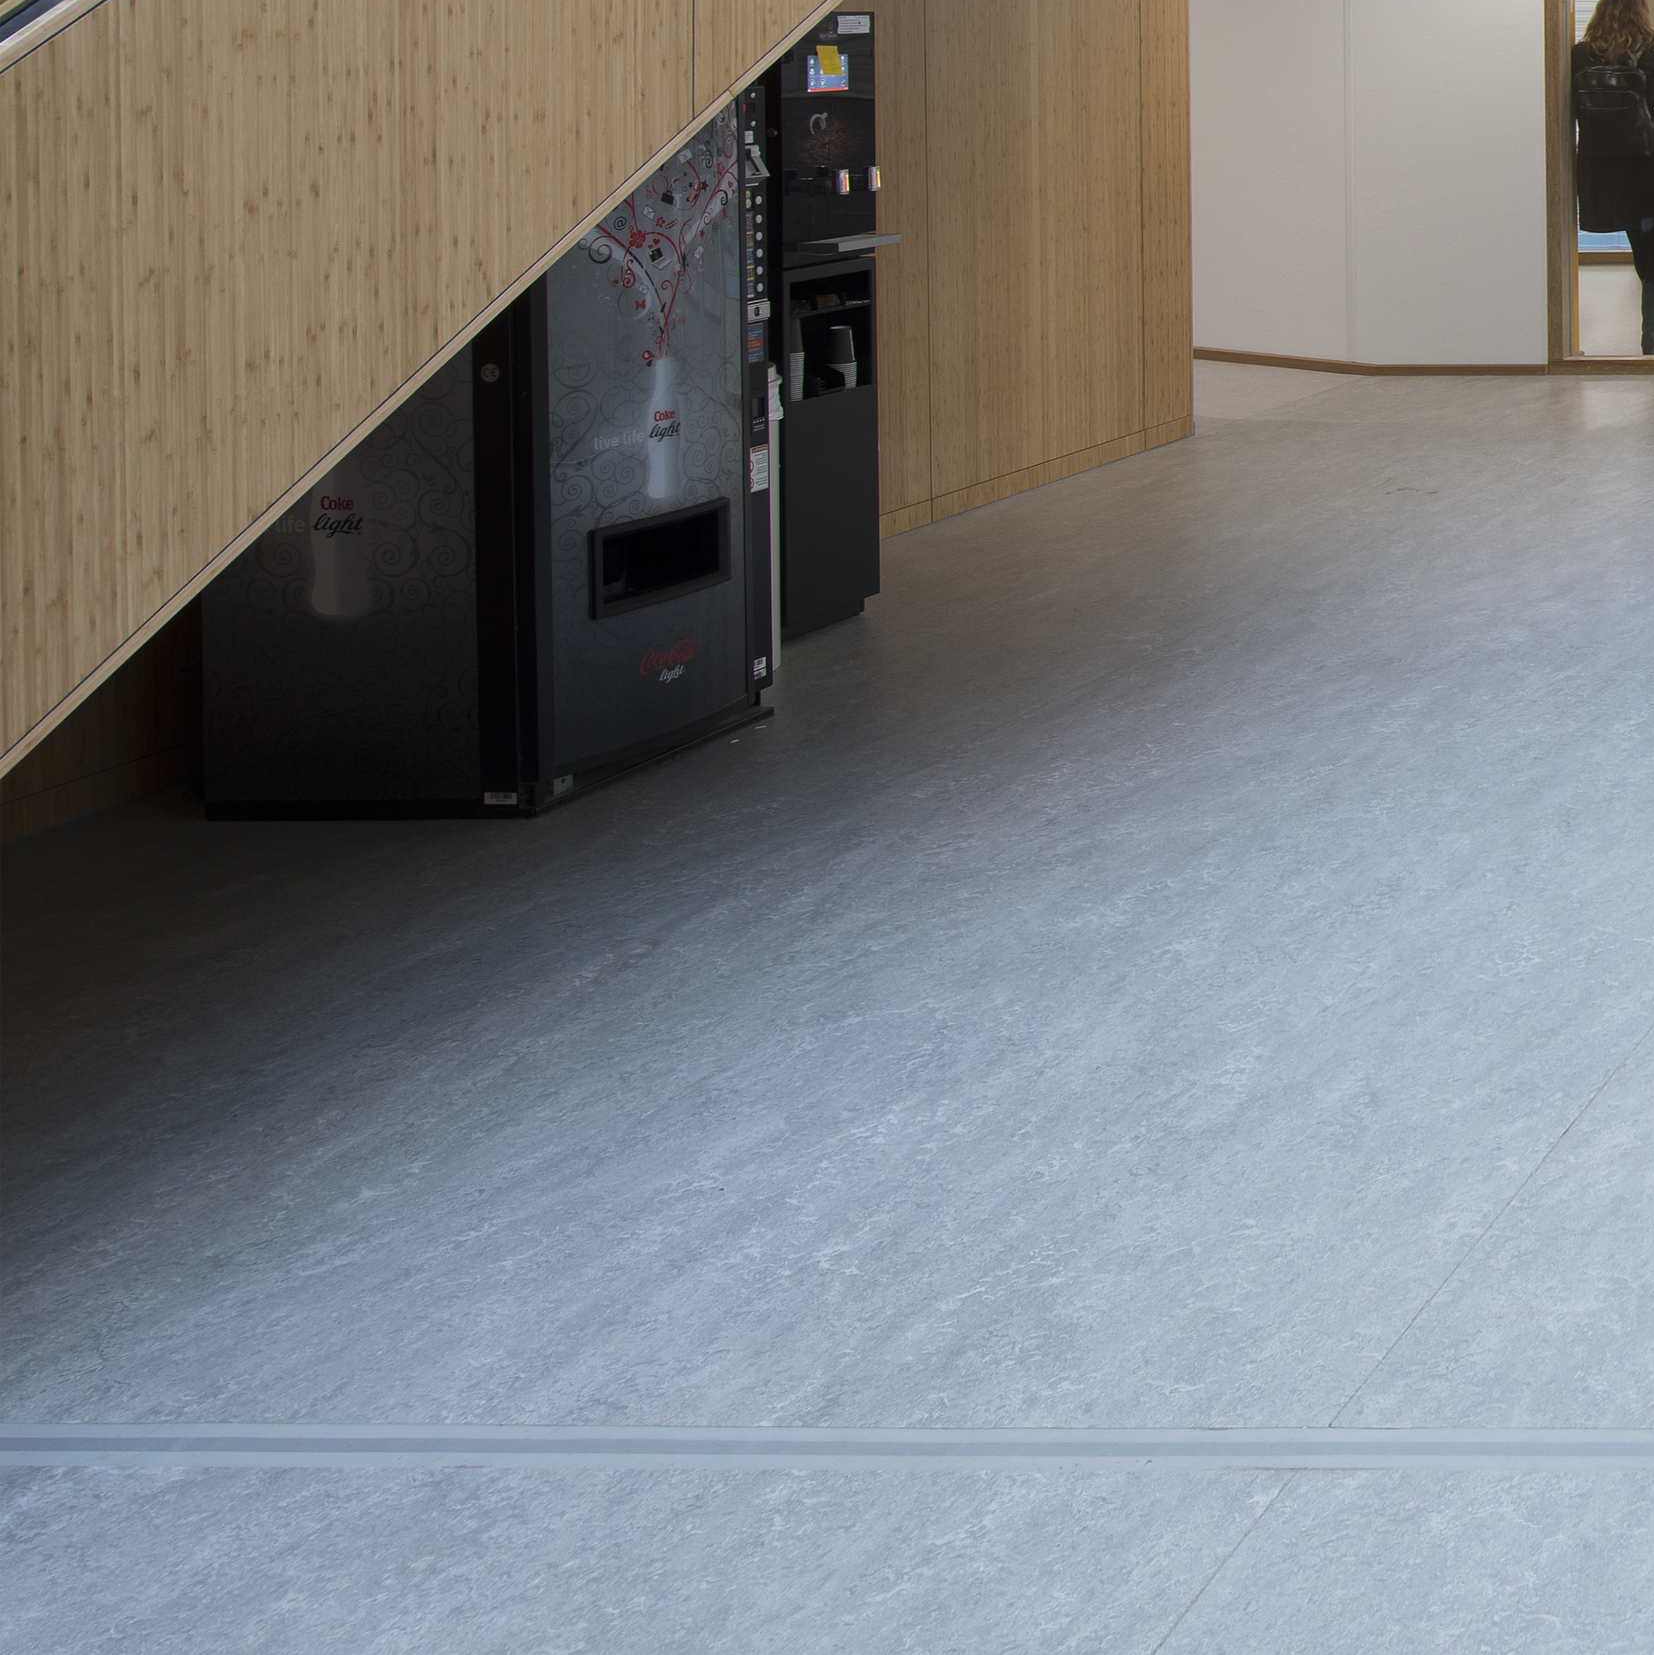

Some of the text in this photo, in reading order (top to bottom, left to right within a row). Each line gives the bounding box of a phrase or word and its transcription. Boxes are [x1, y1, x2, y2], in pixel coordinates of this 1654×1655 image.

[654, 410, 675, 422] Coke
[593, 420, 681, 450] live life light
[320, 495, 354, 510] Coke
[311, 513, 364, 538] light
[659, 664, 684, 684] light
